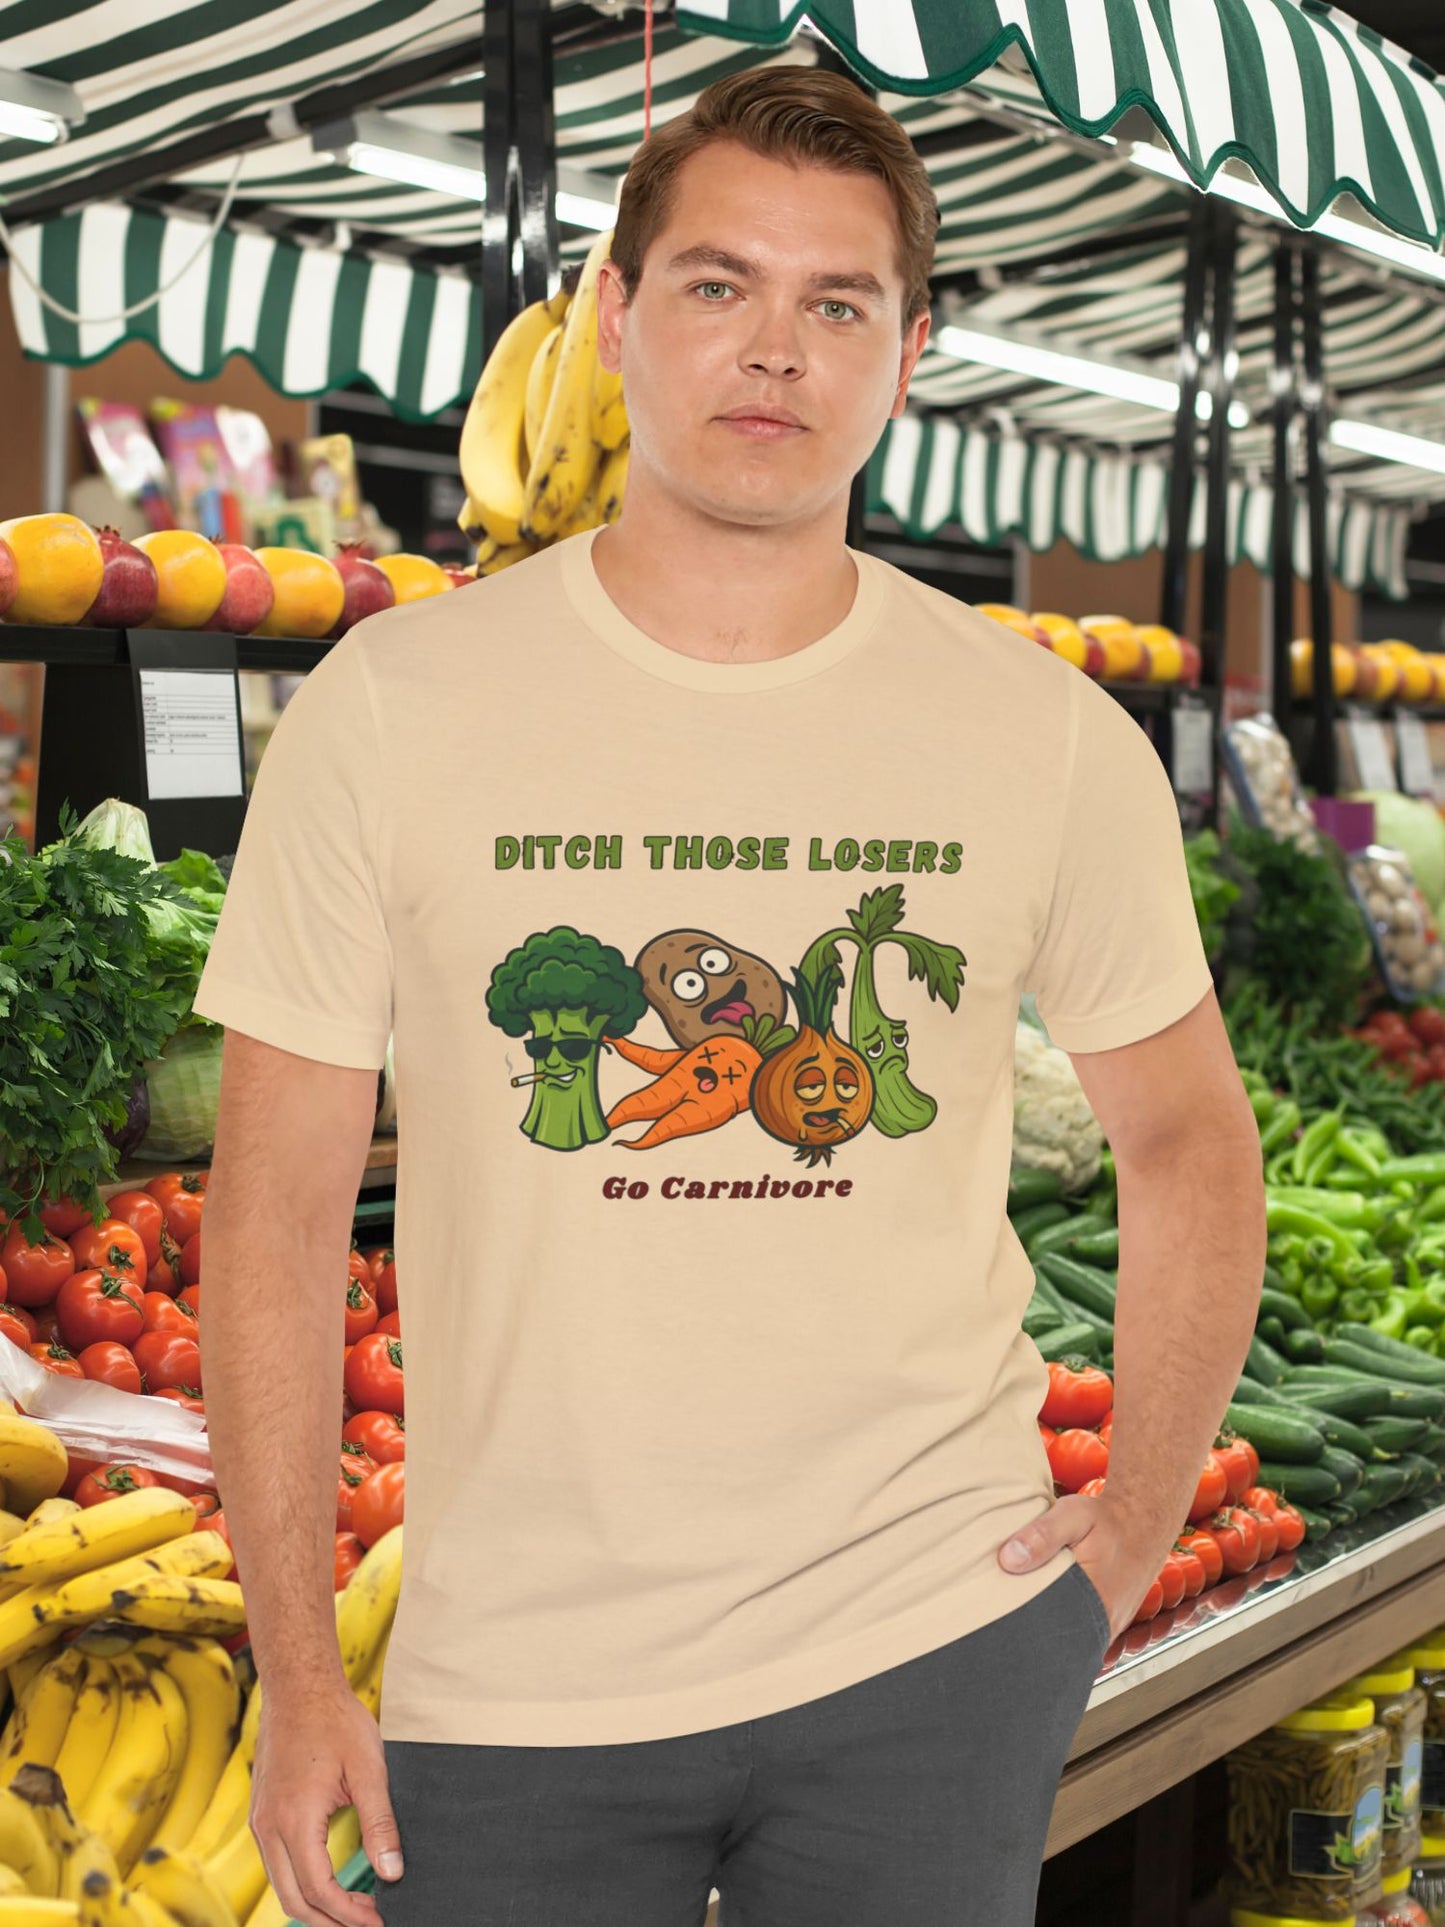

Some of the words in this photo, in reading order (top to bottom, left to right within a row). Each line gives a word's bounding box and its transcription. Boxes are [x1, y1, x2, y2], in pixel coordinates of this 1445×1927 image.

[494, 835, 624, 871] DITCH
[643, 836, 790, 871] THOSE
[807, 837, 964, 875] LOSERS
[602, 1176, 650, 1200] Go
[660, 1174, 853, 1200] Carnivore
